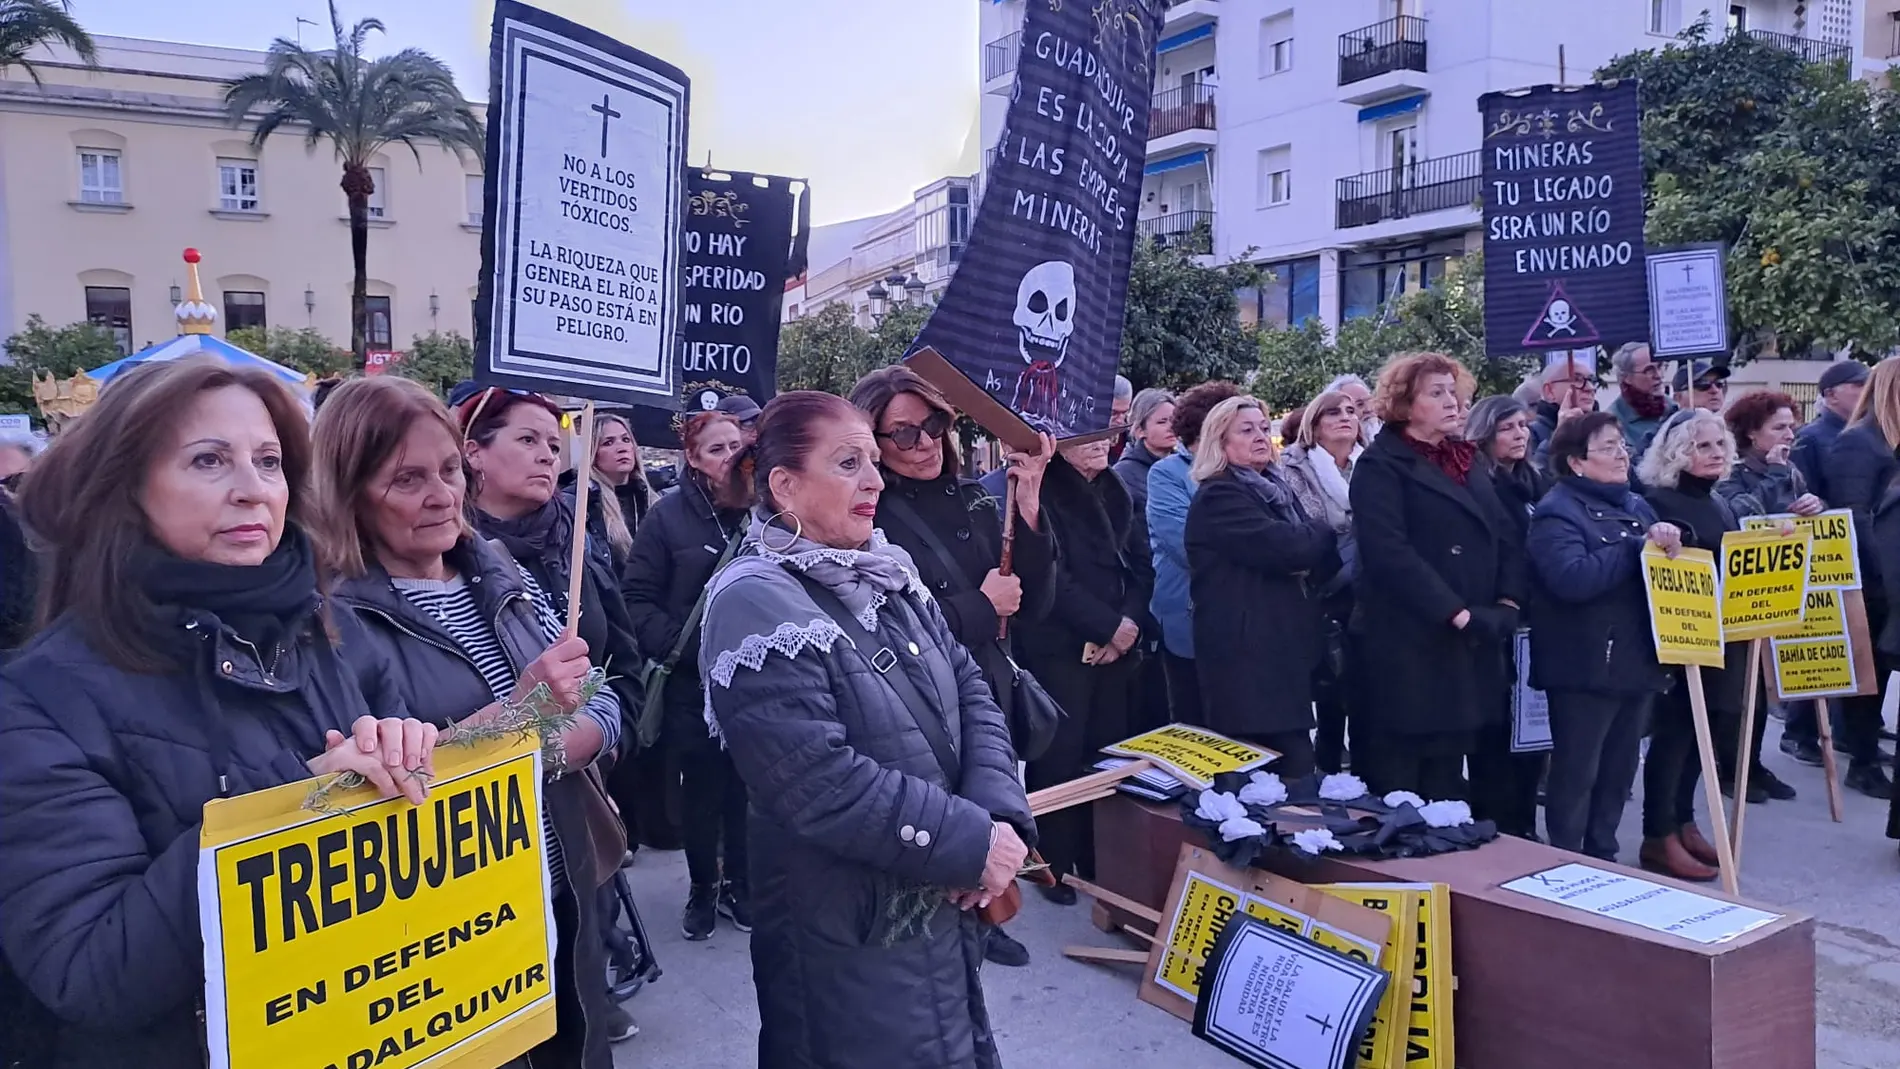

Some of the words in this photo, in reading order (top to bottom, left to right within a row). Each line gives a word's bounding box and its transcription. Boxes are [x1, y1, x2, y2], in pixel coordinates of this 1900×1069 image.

[1037, 86, 1067, 122] ES
[563, 153, 586, 175] NO
[590, 163, 602, 180] A
[606, 166, 635, 189] LOS
[1018, 136, 1065, 176] LAS
[1495, 141, 1594, 171] MINERAS
[559, 176, 638, 212] VERTIDOS
[1493, 181, 1520, 206] TU
[1534, 175, 1613, 202] LEGADO
[561, 200, 633, 234] TÓXICOS.
[1012, 189, 1102, 255] MINERAS
[1490, 212, 1537, 240] SERÁ
[1542, 211, 1565, 236] UN
[1571, 205, 1611, 235] RÍO
[708, 232, 747, 257] HAY
[1516, 241, 1632, 273] ENVENADO
[530, 240, 552, 260] LA
[556, 246, 626, 276] RIQUEZA
[629, 263, 658, 283] QUE
[525, 263, 592, 292] GENERA
[596, 278, 615, 296] EL
[619, 281, 645, 302] RÍO
[647, 289, 657, 305] A
[523, 286, 546, 305] SU
[549, 291, 592, 314] PASO
[596, 301, 635, 322] ESTÁ
[638, 309, 657, 326] EN
[556, 316, 629, 343] PELIGRO.
[682, 341, 751, 374] UERTO
[1729, 543, 1804, 577] GELVES
[1650, 565, 1684, 593] PUEBLA
[1684, 570, 1700, 595] DEL
[1729, 590, 1743, 599] EN
[1747, 584, 1795, 597] DEFENSA
[1660, 606, 1672, 615] EN
[1675, 608, 1712, 619] DEFENSA
[1751, 600, 1771, 609] DEL
[1660, 634, 1720, 647] GUADALQUIVIR
[1681, 622, 1698, 631] DEL
[1780, 645, 1805, 663] BAHÍA
[1807, 647, 1818, 660] DE
[1820, 642, 1846, 660] CÁDIZ
[1800, 667, 1841, 675] DEFENSA
[1158, 727, 1260, 763] MARISMILLAS
[1160, 748, 1184, 757] DEL
[1163, 742, 1222, 768] DEFENSA
[1119, 743, 1213, 780] GUADALQUIVIR
[236, 773, 531, 953] TREBUJENA
[1201, 893, 1210, 911] EN
[1182, 918, 1193, 942] DEL
[266, 979, 326, 1026] EN
[344, 902, 516, 993] DEFENSA
[1280, 953, 1299, 977] VIDA
[1291, 964, 1303, 978] LA
[369, 977, 444, 1025] DEL
[1238, 955, 1264, 1015] PRIORIDAD
[1247, 965, 1269, 1015] NUESTRA
[1255, 974, 1275, 1020] GRANDE
[1274, 978, 1285, 995] DE
[1277, 980, 1297, 1016] SALUD
[324, 963, 546, 1069] DALQUIVIR
[1252, 1020, 1261, 1036] ES
[1259, 995, 1278, 1048] NUESTRO
[1274, 1017, 1282, 1026] Y
[1269, 1027, 1279, 1042] LA
